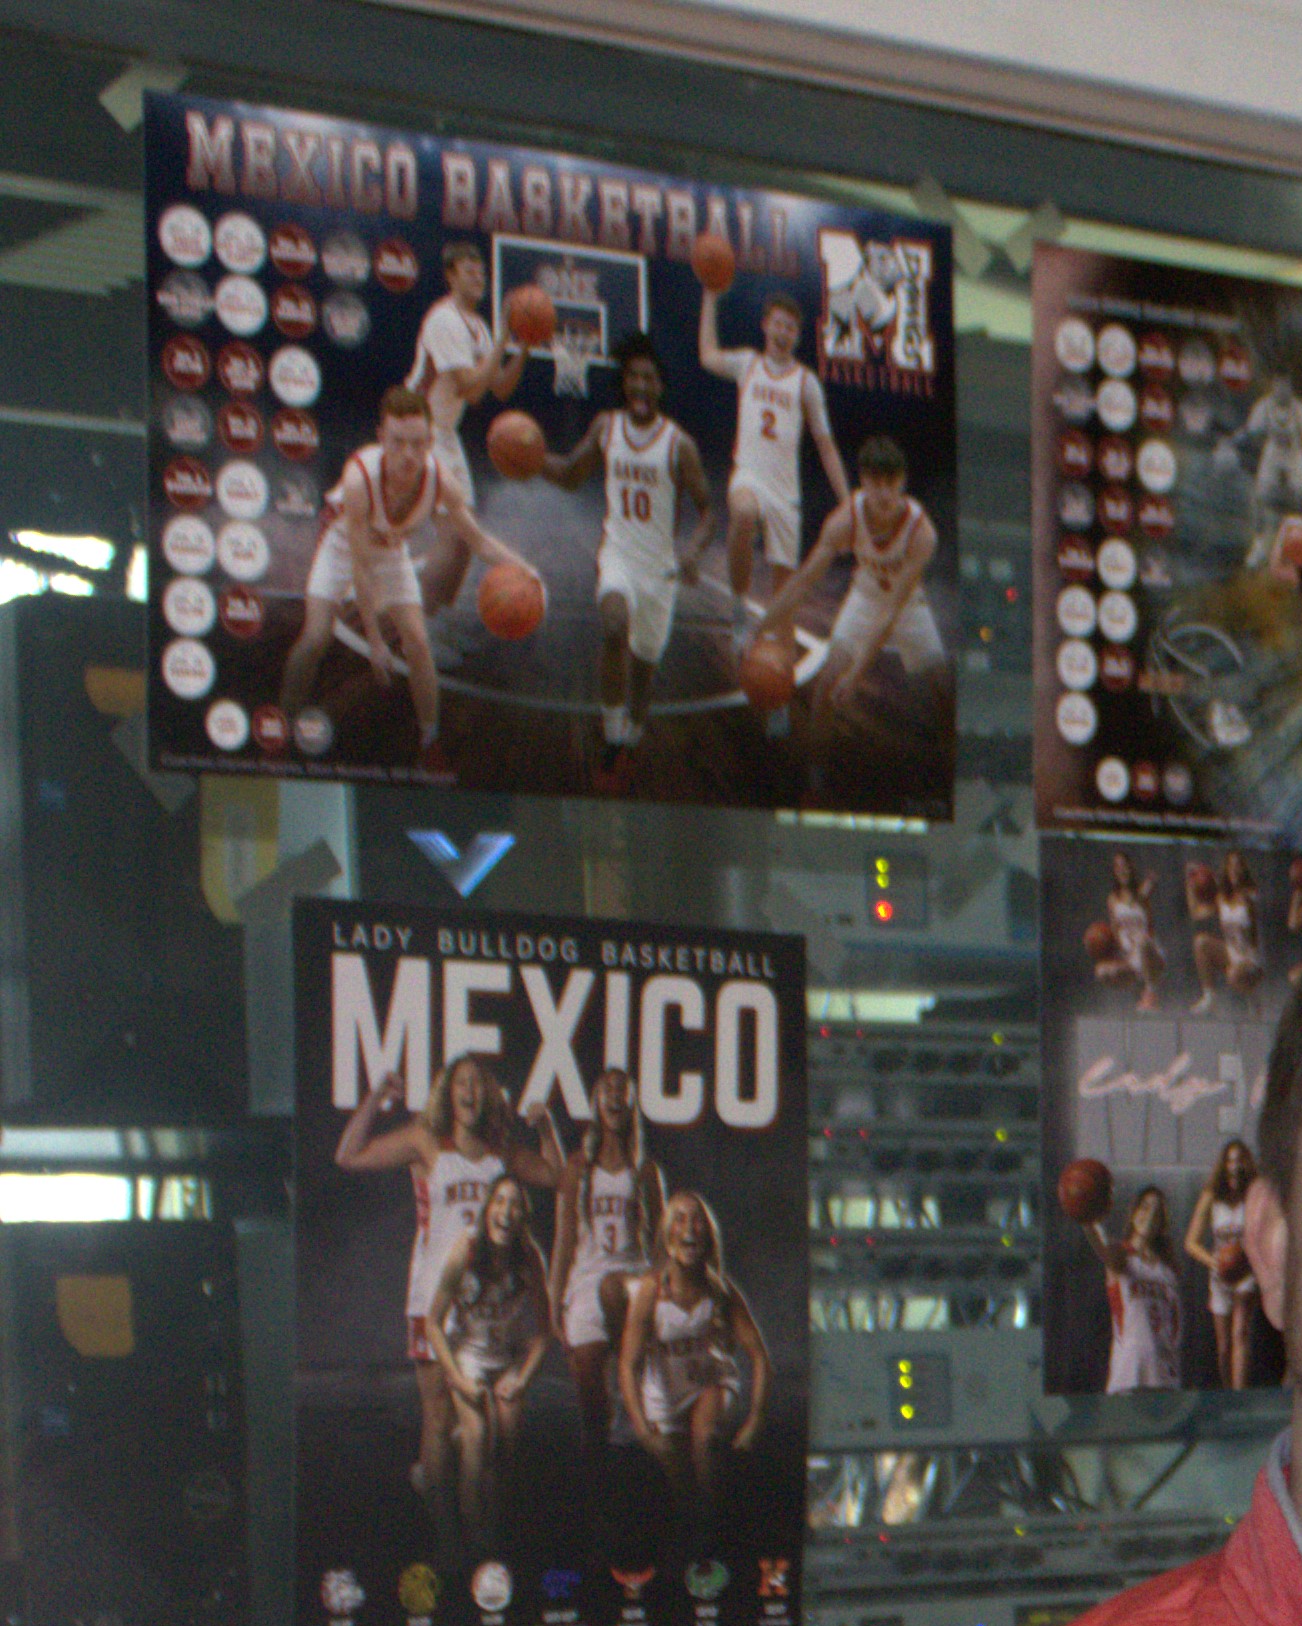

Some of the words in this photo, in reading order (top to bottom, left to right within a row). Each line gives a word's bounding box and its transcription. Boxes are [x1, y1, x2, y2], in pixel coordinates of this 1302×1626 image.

[185, 110, 419, 221] MEXICO
[442, 150, 802, 278] BASKETBALL
[760, 409, 778, 441] 2
[620, 487, 653, 523] 10
[333, 921, 414, 952] LADY
[438, 928, 580, 963] BULLDOG
[602, 941, 776, 979] BASKETBALL
[331, 953, 780, 1130] MEXICO
